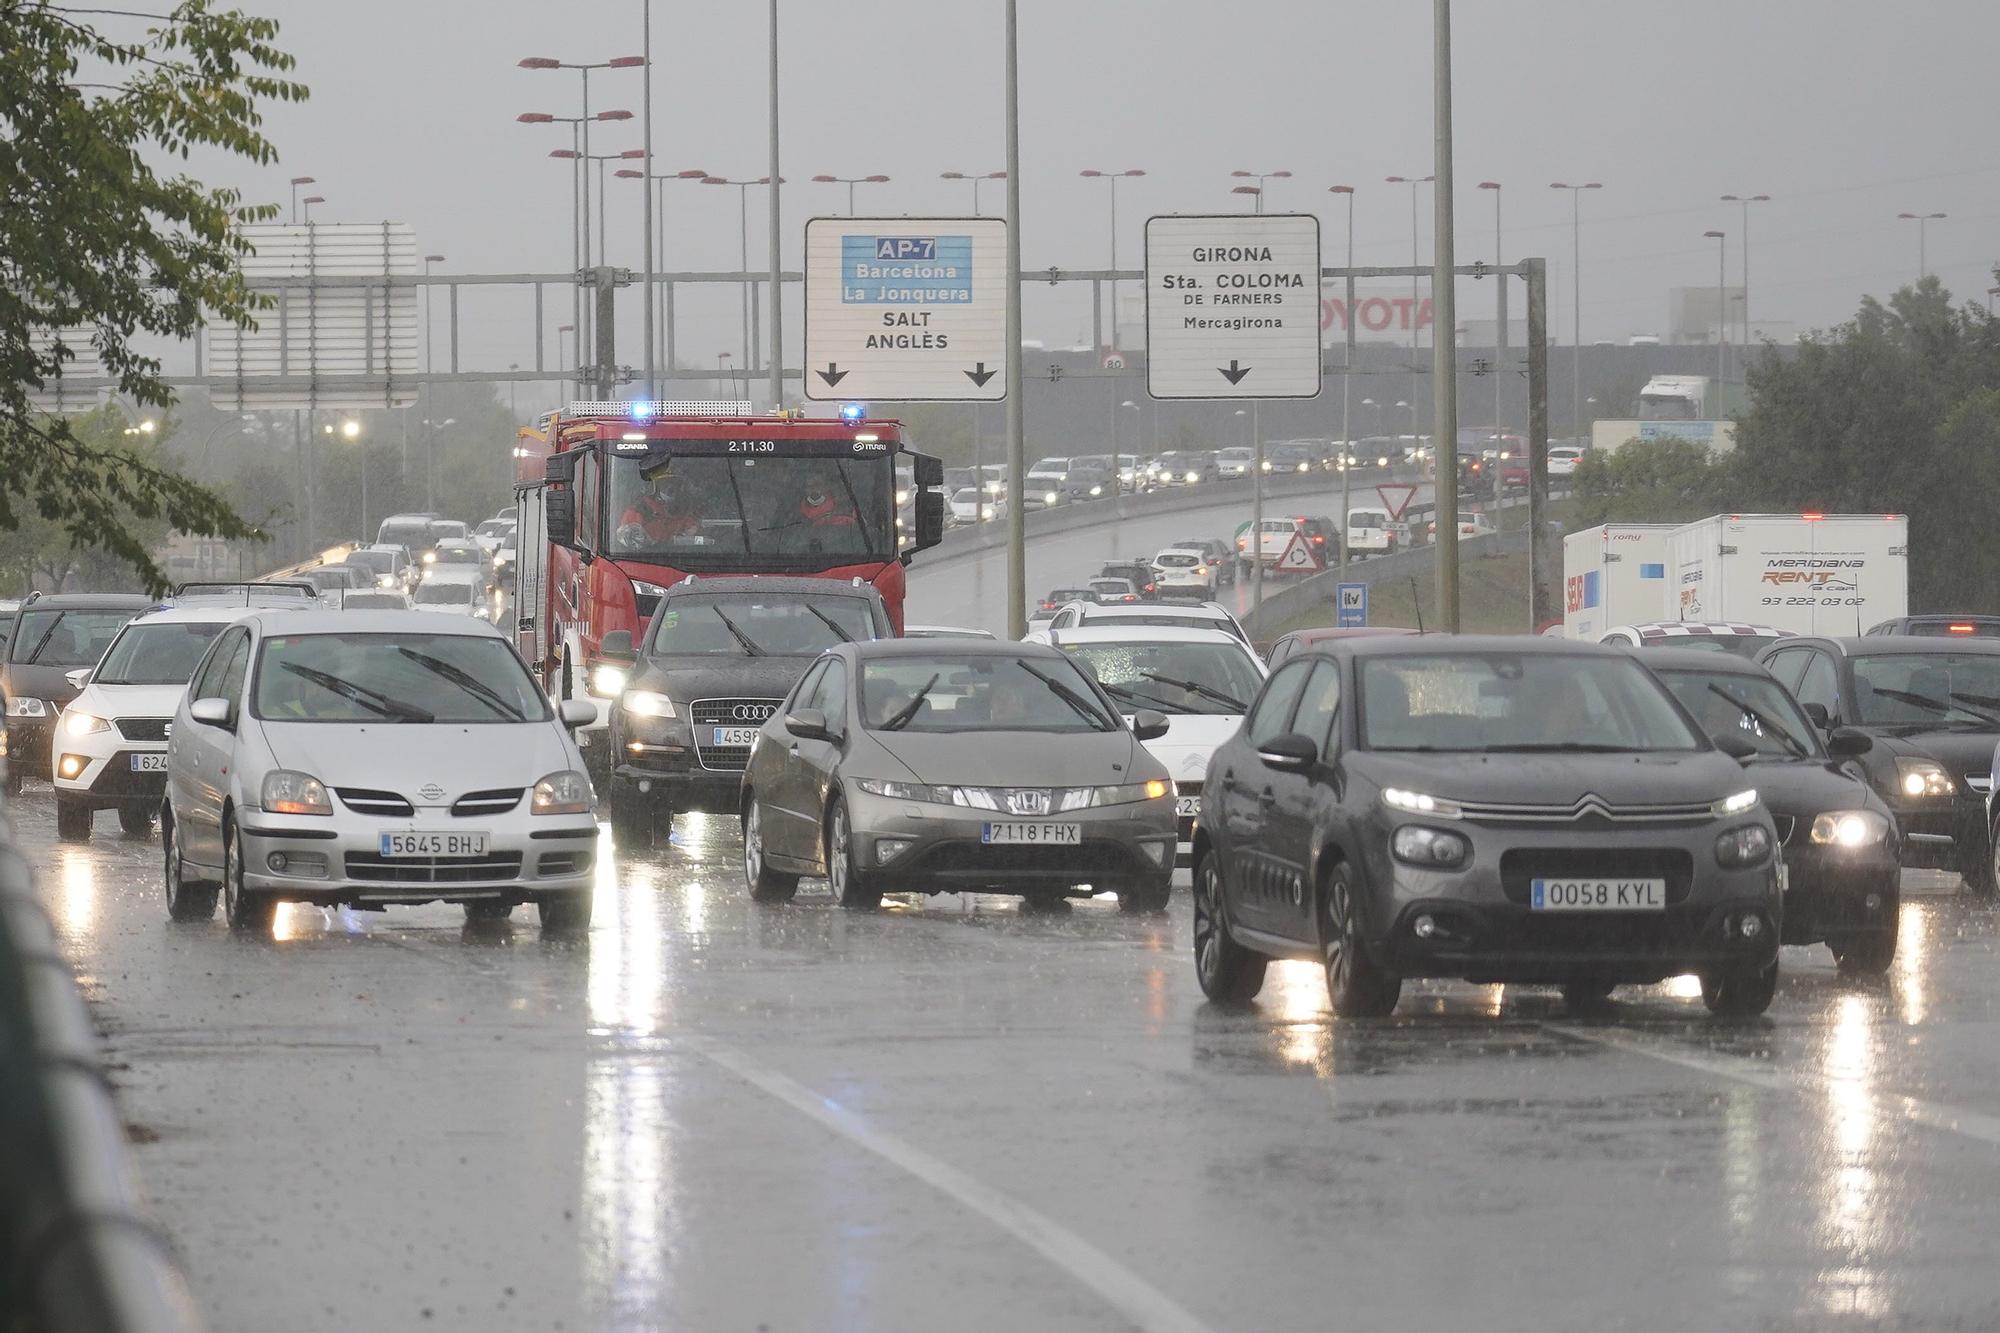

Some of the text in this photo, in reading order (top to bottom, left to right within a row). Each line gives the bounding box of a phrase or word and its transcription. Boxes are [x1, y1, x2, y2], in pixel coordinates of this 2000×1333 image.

[878, 239, 935, 258] AP-7
[1193, 247, 1273, 262] GIRONA
[856, 263, 957, 278] Barcelona
[1163, 273, 1304, 289] Sta. COLOMA
[844, 286, 969, 303] La Jonquera
[1184, 293, 1283, 305] DE FARNERS
[883, 312, 931, 327] SALT
[1184, 316, 1283, 330] Mercagirona
[865, 331, 948, 349] ANGLÈS
[728, 441, 775, 452] 2.11.30
[1761, 597, 1865, 606] 93 222 03 02
[142, 756, 168, 769] 624
[992, 824, 1077, 842] 7118 FHX
[392, 836, 484, 853] 5645 BHJ
[1550, 883, 1659, 905] 0058 KYL
